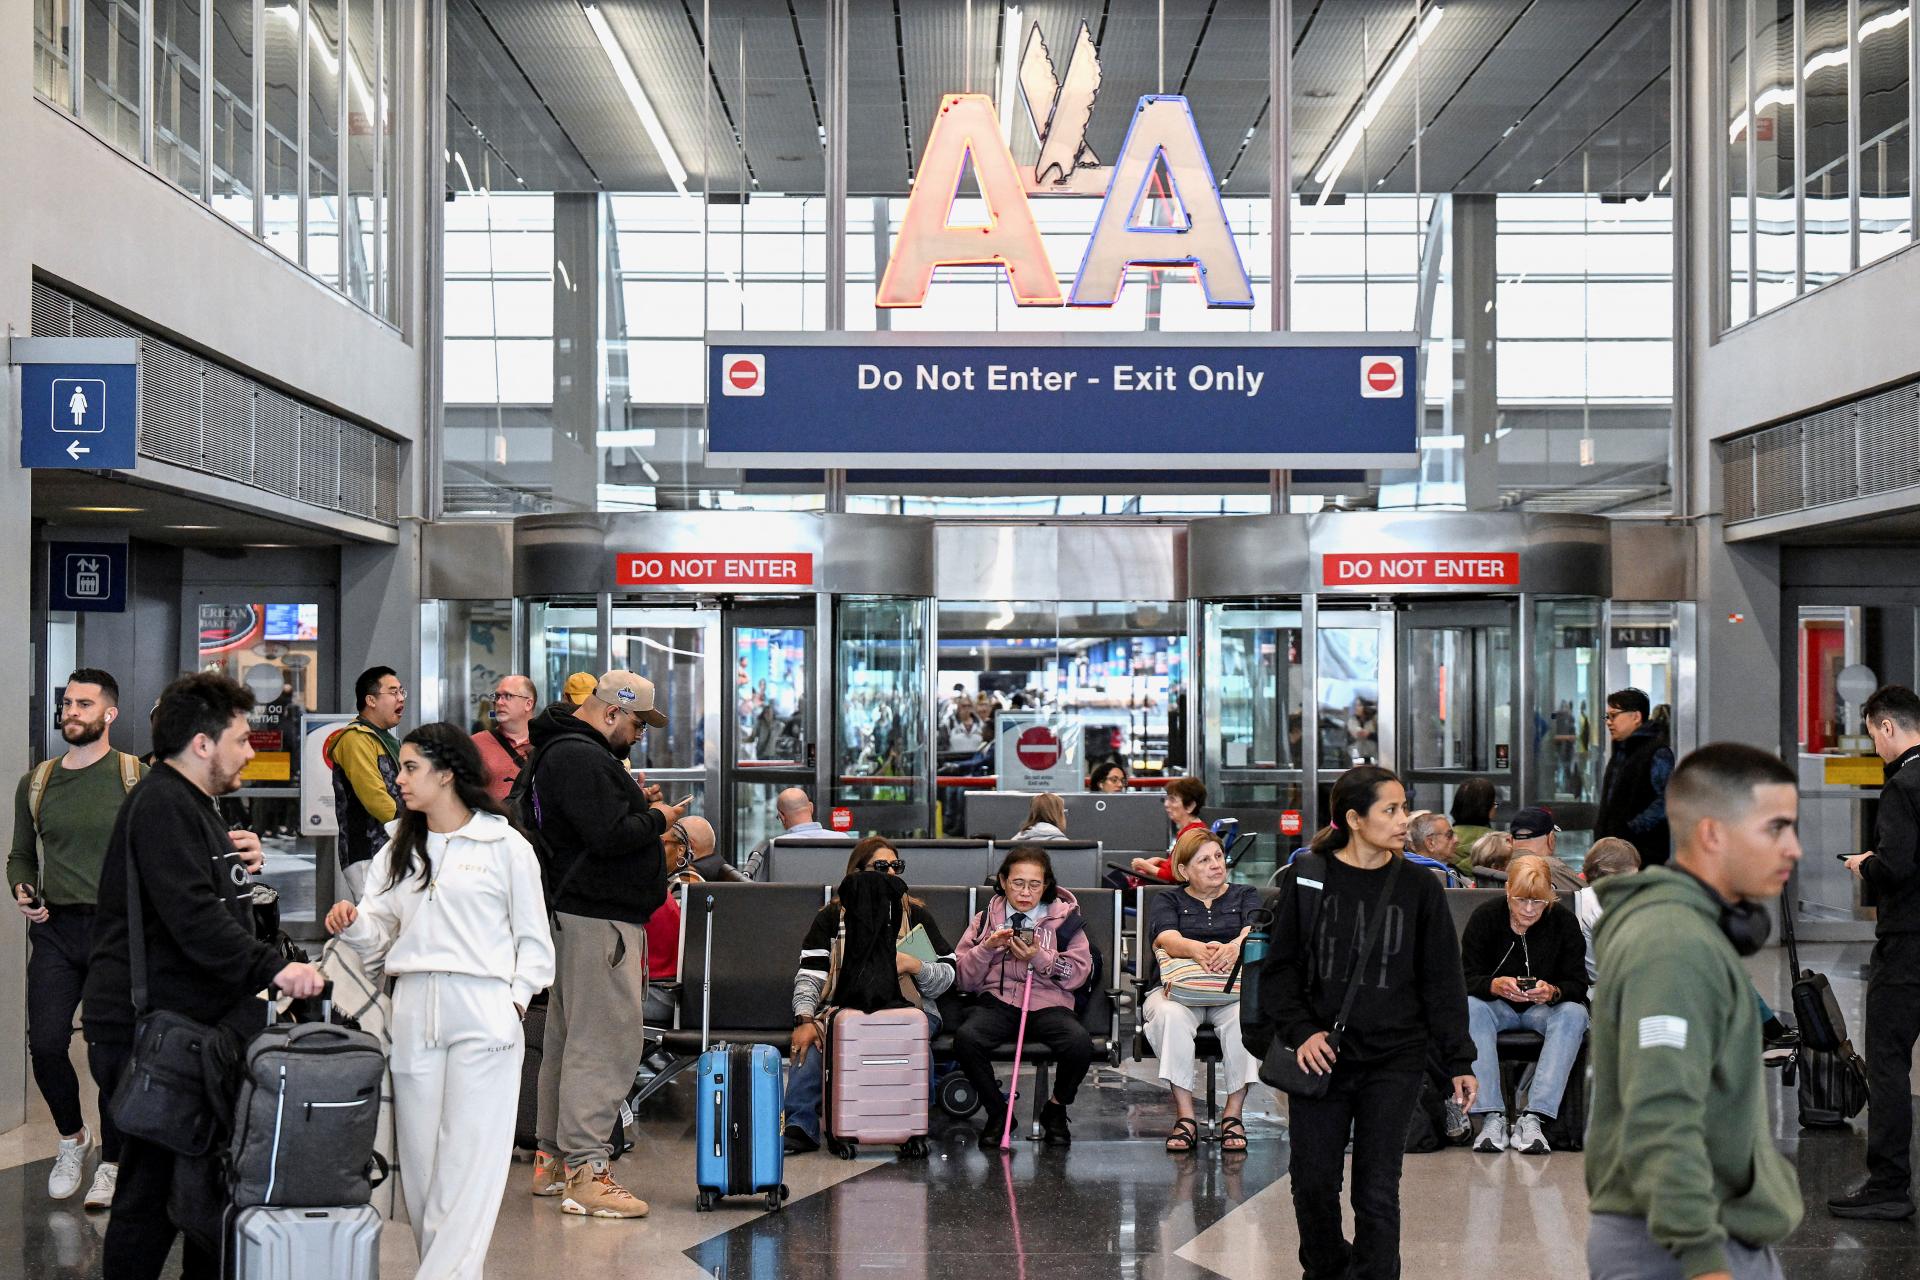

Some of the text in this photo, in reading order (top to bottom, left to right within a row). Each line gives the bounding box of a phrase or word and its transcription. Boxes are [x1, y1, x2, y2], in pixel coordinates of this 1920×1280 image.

[857, 364, 903, 391] Do
[915, 364, 975, 391] Not
[987, 364, 1078, 391] Enter
[1113, 365, 1177, 391] Exit
[1188, 364, 1265, 397] Only
[631, 559, 797, 578] DO NOT ENTER
[1339, 559, 1505, 579] DO NOT ENTER
